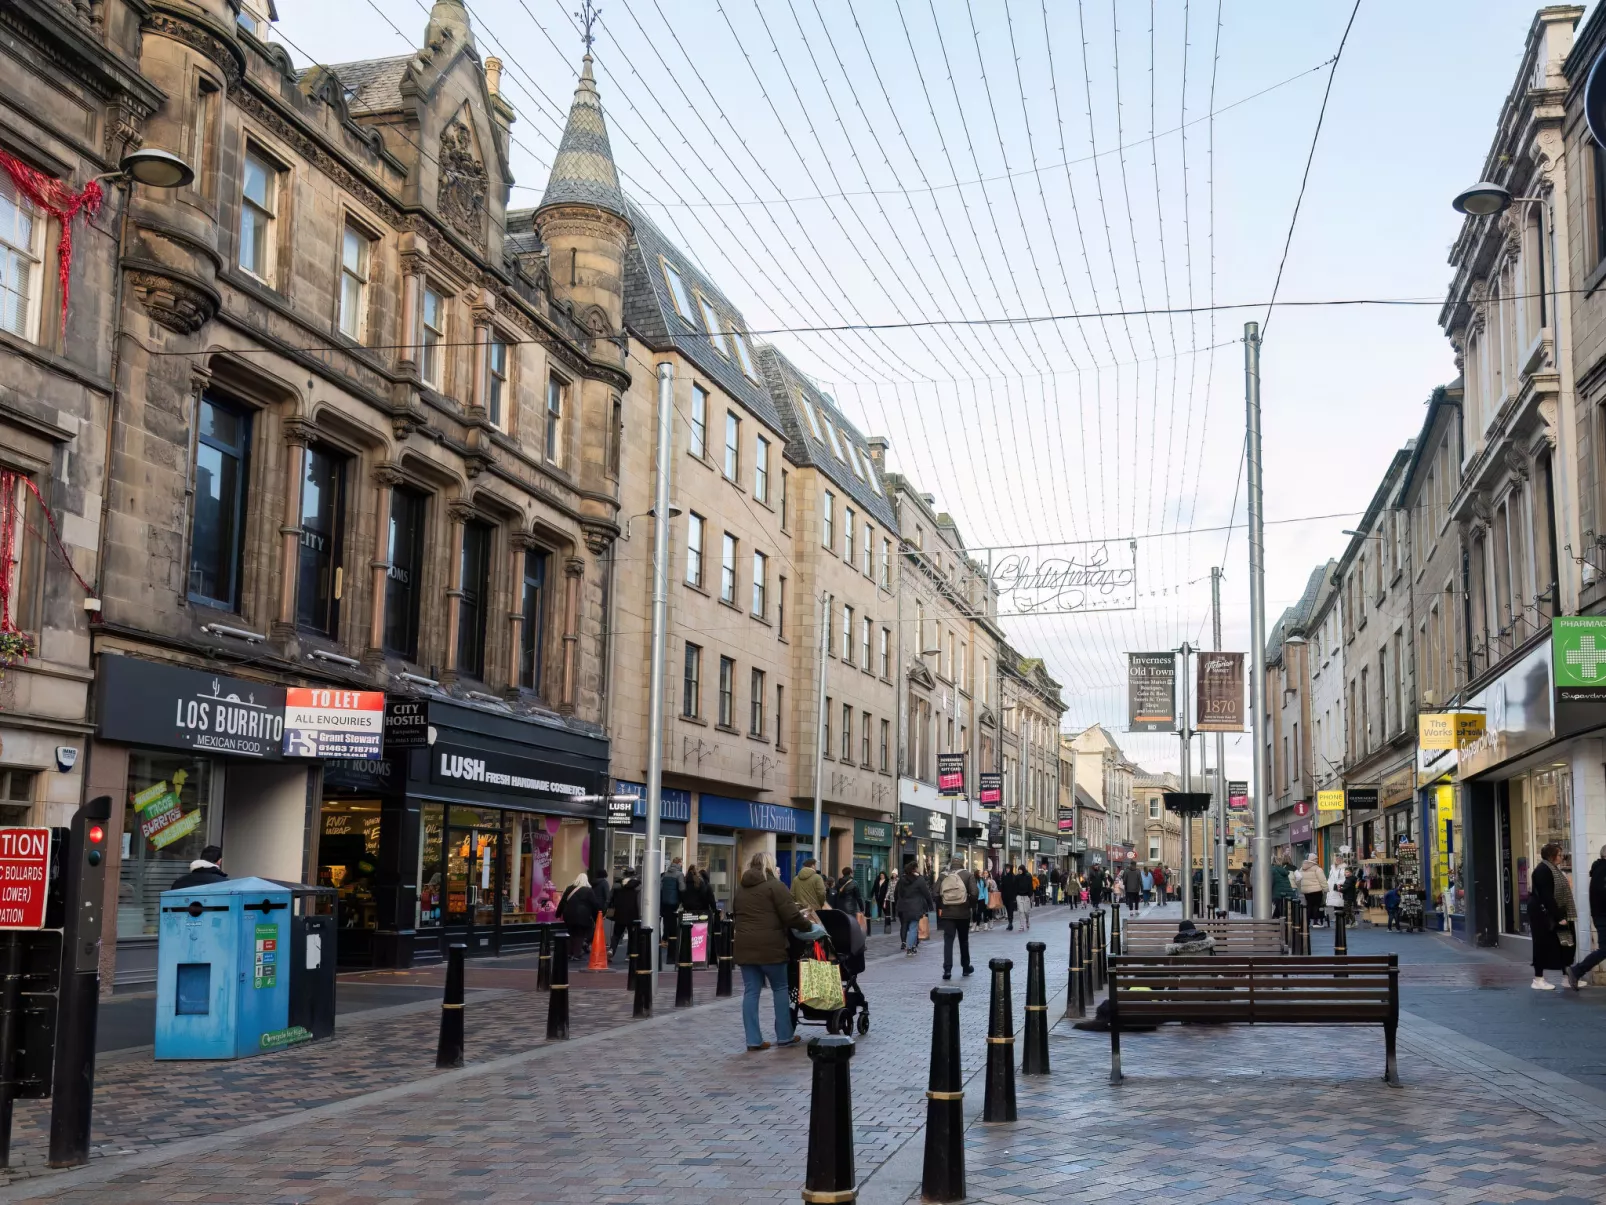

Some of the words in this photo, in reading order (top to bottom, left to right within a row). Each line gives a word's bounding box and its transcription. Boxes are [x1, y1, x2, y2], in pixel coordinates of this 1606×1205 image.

[991, 554, 1133, 610] Christmas
[1132, 656, 1172, 664] Inverness
[1130, 667, 1146, 676] Old
[1148, 668, 1174, 676] Town
[311, 690, 330, 707] TO
[334, 691, 360, 708] LET
[1206, 700, 1236, 713] 1870
[393, 704, 419, 714] CITY
[176, 698, 210, 730] LOS
[215, 705, 283, 742] BURRITO
[295, 714, 314, 724] ALL
[317, 715, 372, 726] ENQUIRIES
[386, 715, 426, 726] HOSTEL
[197, 734, 235, 748] MEXICAN
[237, 740, 260, 752] FOOD
[320, 733, 344, 742] Grant
[345, 734, 380, 744] Stewart
[1461, 728, 1498, 762] Superdrug
[353, 760, 391, 777] ROOMS
[440, 754, 485, 782] LUSH
[486, 772, 511, 786] FRESH
[511, 776, 550, 792] HANDMADE
[550, 782, 585, 796] COSMETICS
[148, 796, 174, 817] TACOS
[142, 807, 181, 838] BURRITOS
[326, 816, 352, 827] KNOT
[749, 803, 796, 832] WHSmith
[2, 834, 45, 856] TION
[5, 866, 43, 880] BOLLARDS
[2, 886, 31, 903] LOWER)
[0, 908, 24, 923] ATION
